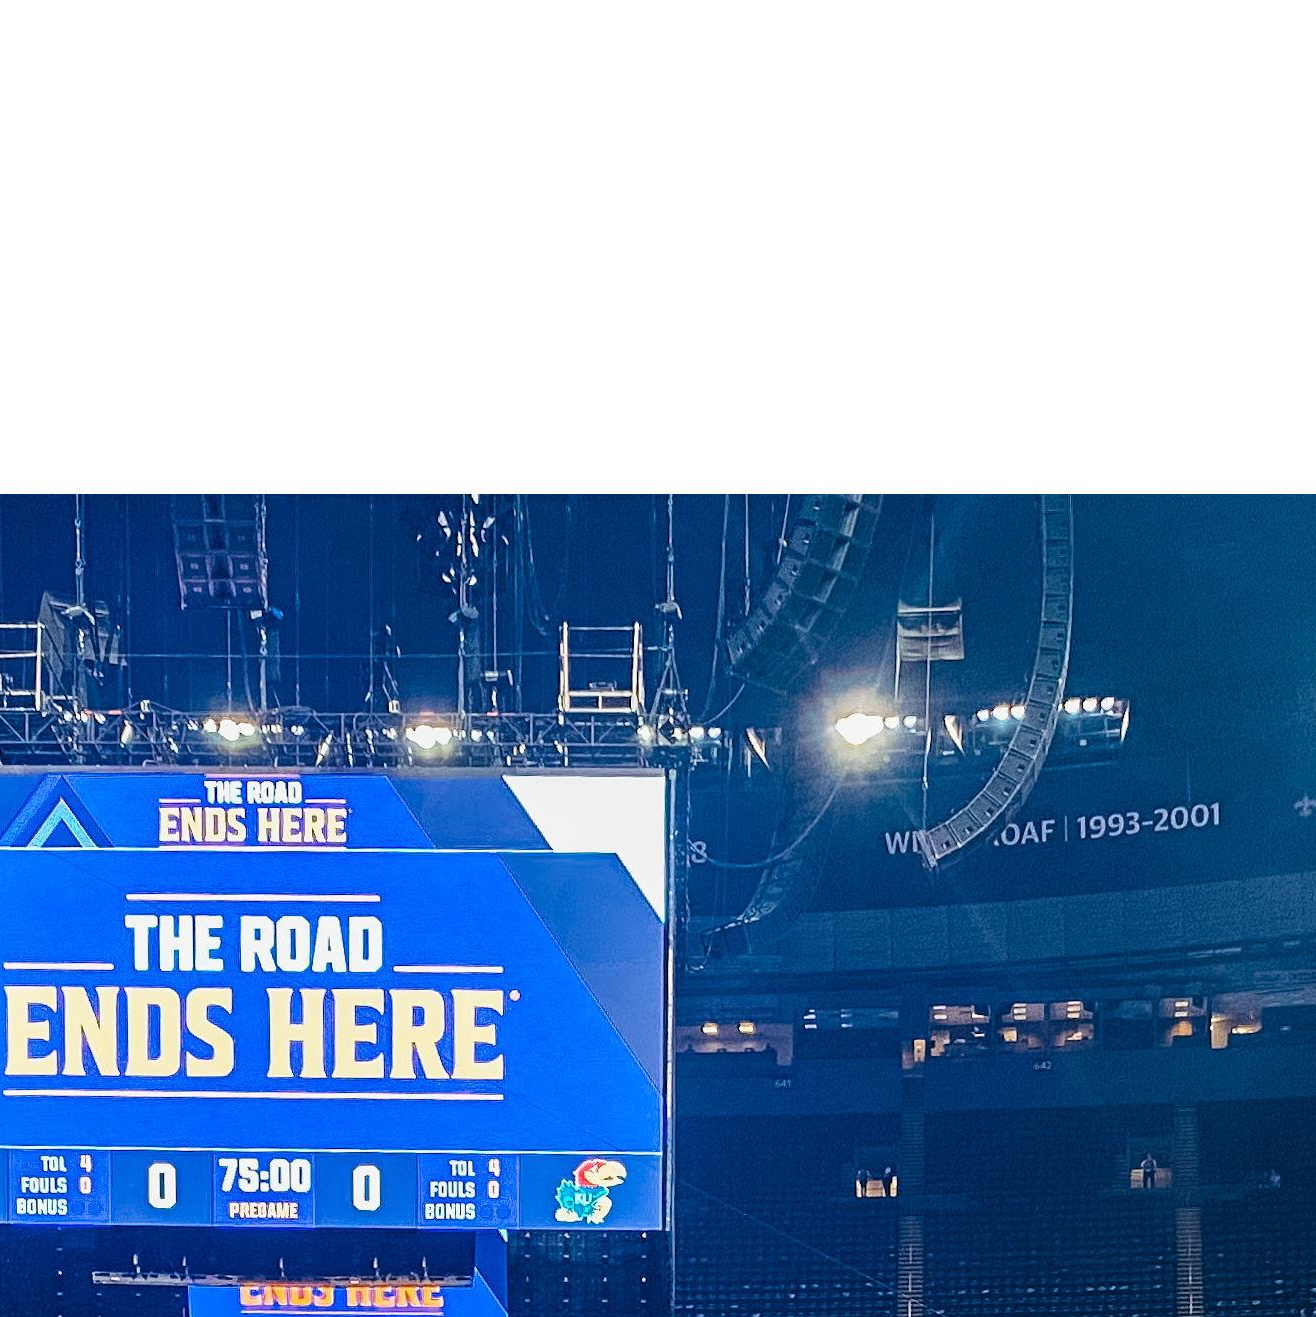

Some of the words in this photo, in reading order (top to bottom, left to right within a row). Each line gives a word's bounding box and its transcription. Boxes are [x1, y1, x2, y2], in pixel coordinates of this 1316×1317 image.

[204, 780, 243, 804] THE
[246, 781, 302, 805] ROAD
[158, 807, 247, 843] ENDS
[258, 808, 347, 843] HERE
[1077, 802, 1222, 841] 1993-2001
[125, 914, 224, 972] THE
[240, 915, 383, 973] ROAD
[3, 985, 236, 1077] ENDS
[266, 988, 505, 1081] HERE
[40, 1155, 67, 1173] TOL
[79, 1155, 92, 1173] 4
[219, 1158, 311, 1194] 75:00
[449, 1159, 476, 1177] TOL
[488, 1158, 500, 1178] 4
[21, 1176, 68, 1195] FOULS
[79, 1176, 92, 1195] 0
[148, 1163, 177, 1209] 0
[352, 1165, 381, 1212] 0
[429, 1180, 476, 1199] FOULS
[488, 1180, 500, 1199] 0
[16, 1198, 68, 1216] BONUS
[229, 1202, 299, 1220] PREGAME
[424, 1202, 476, 1221] BONUS
